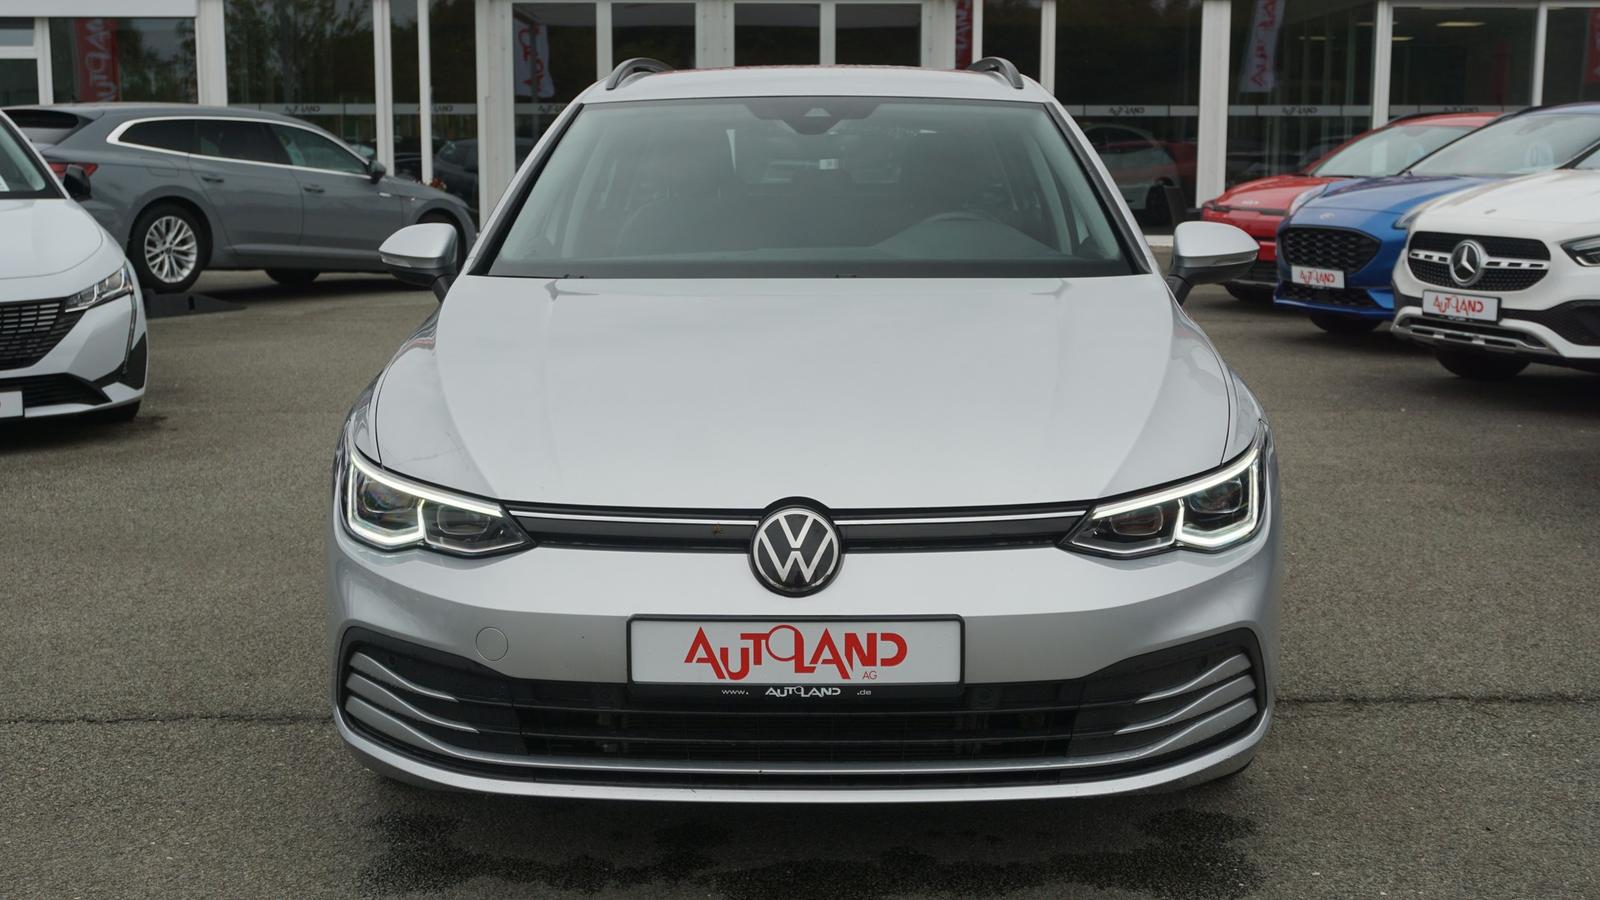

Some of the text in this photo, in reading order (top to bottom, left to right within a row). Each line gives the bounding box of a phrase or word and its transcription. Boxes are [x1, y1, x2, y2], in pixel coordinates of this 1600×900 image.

[684, 624, 908, 681] AUTOLAND
[862, 670, 878, 681] AG
[721, 685, 872, 698] www. AUTOLAND .de
